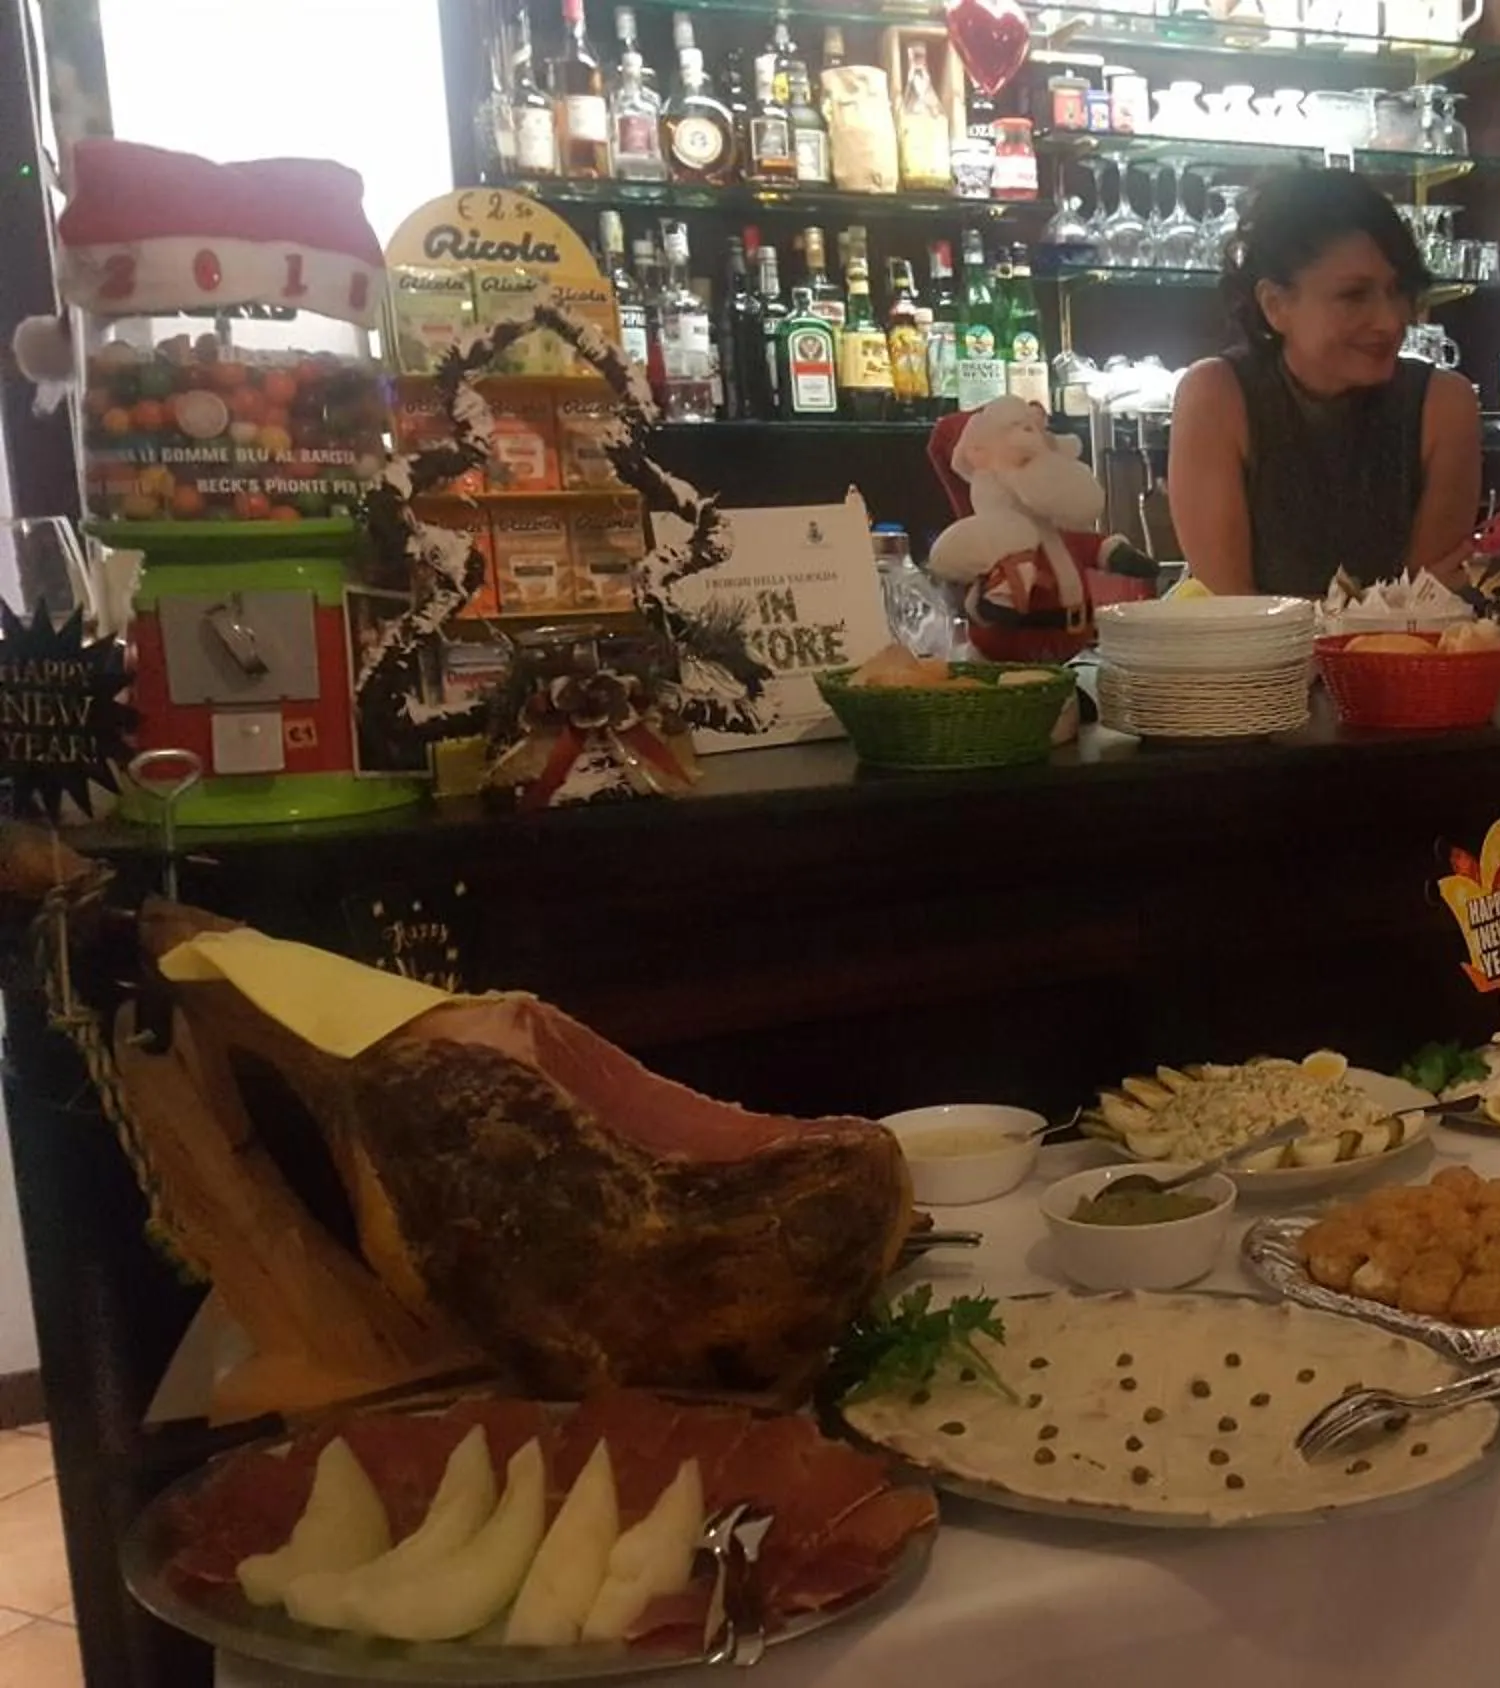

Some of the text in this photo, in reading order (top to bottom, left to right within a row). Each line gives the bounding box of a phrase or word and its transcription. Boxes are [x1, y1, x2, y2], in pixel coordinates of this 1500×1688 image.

[423, 225, 561, 264] Ricola
[160, 447, 229, 463] GOMME
[235, 448, 269, 463] BLU
[196, 478, 260, 494] BECK'S
[265, 479, 328, 494] PRONTE
[2, 690, 95, 726] NEW
